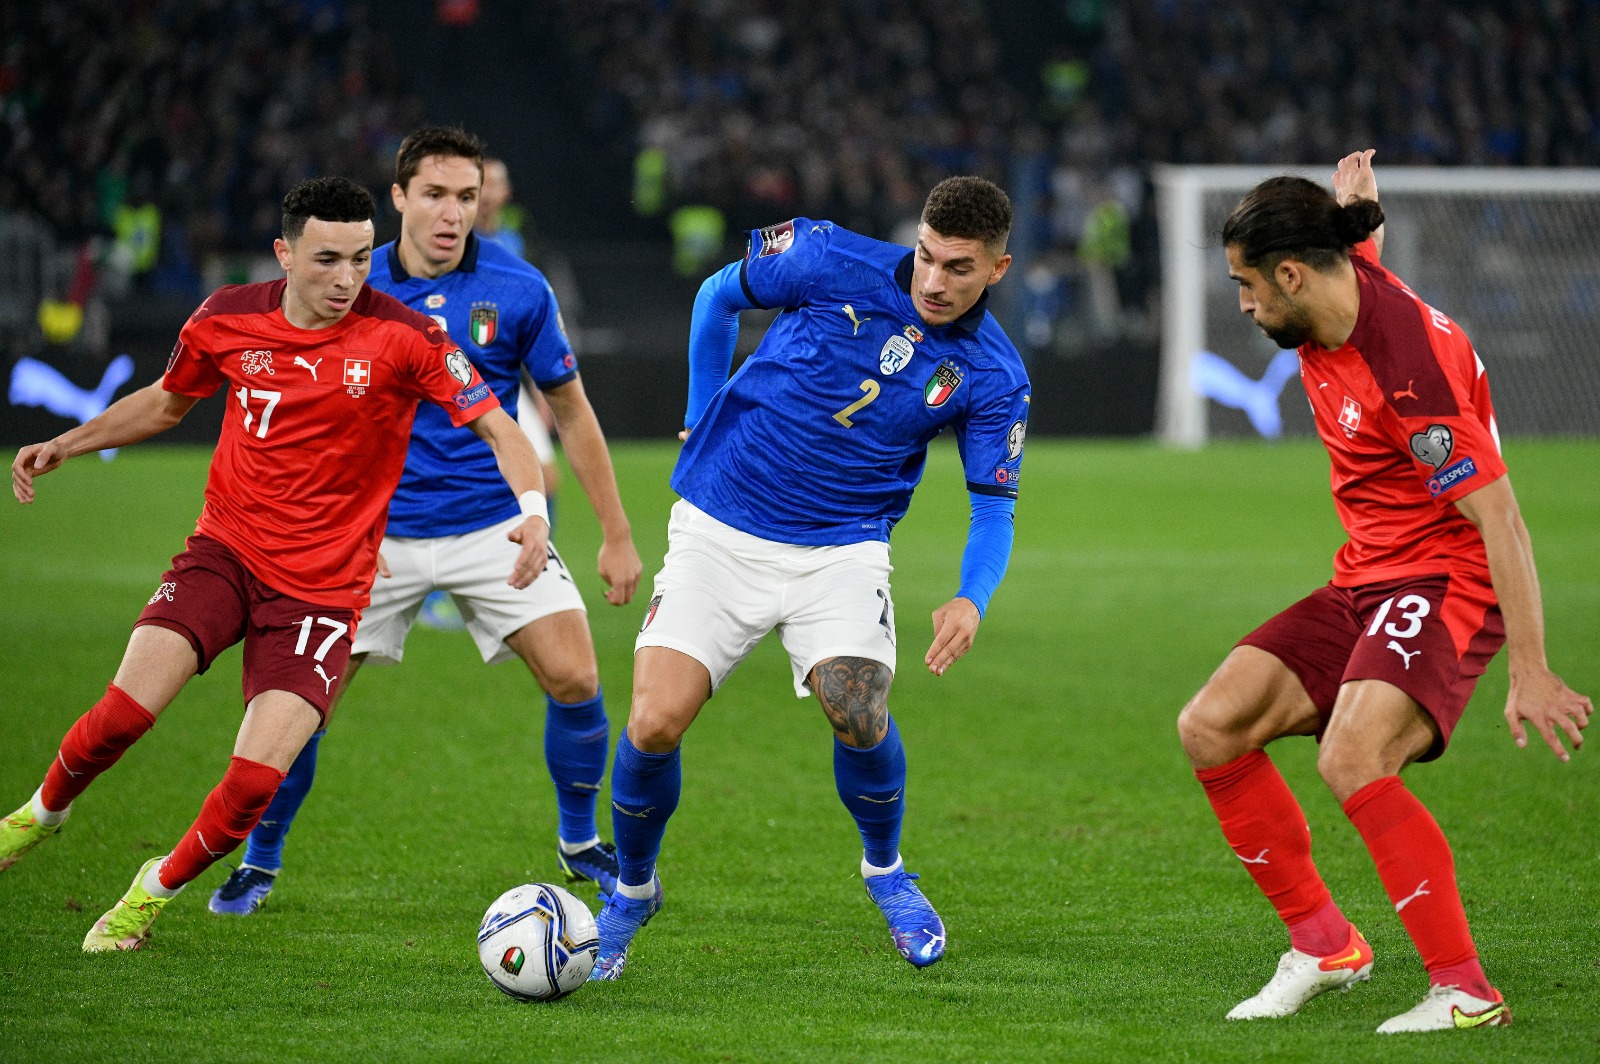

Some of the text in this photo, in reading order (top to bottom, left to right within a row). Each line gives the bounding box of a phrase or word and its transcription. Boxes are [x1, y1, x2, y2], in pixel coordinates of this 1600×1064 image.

[467, 385, 489, 402] RESPECT
[938, 367, 959, 386] ITALIA
[235, 386, 282, 439] 17
[832, 378, 880, 429] 2
[1439, 461, 1474, 486] RESPECT
[1366, 594, 1431, 638] 13
[291, 615, 348, 662] 17
